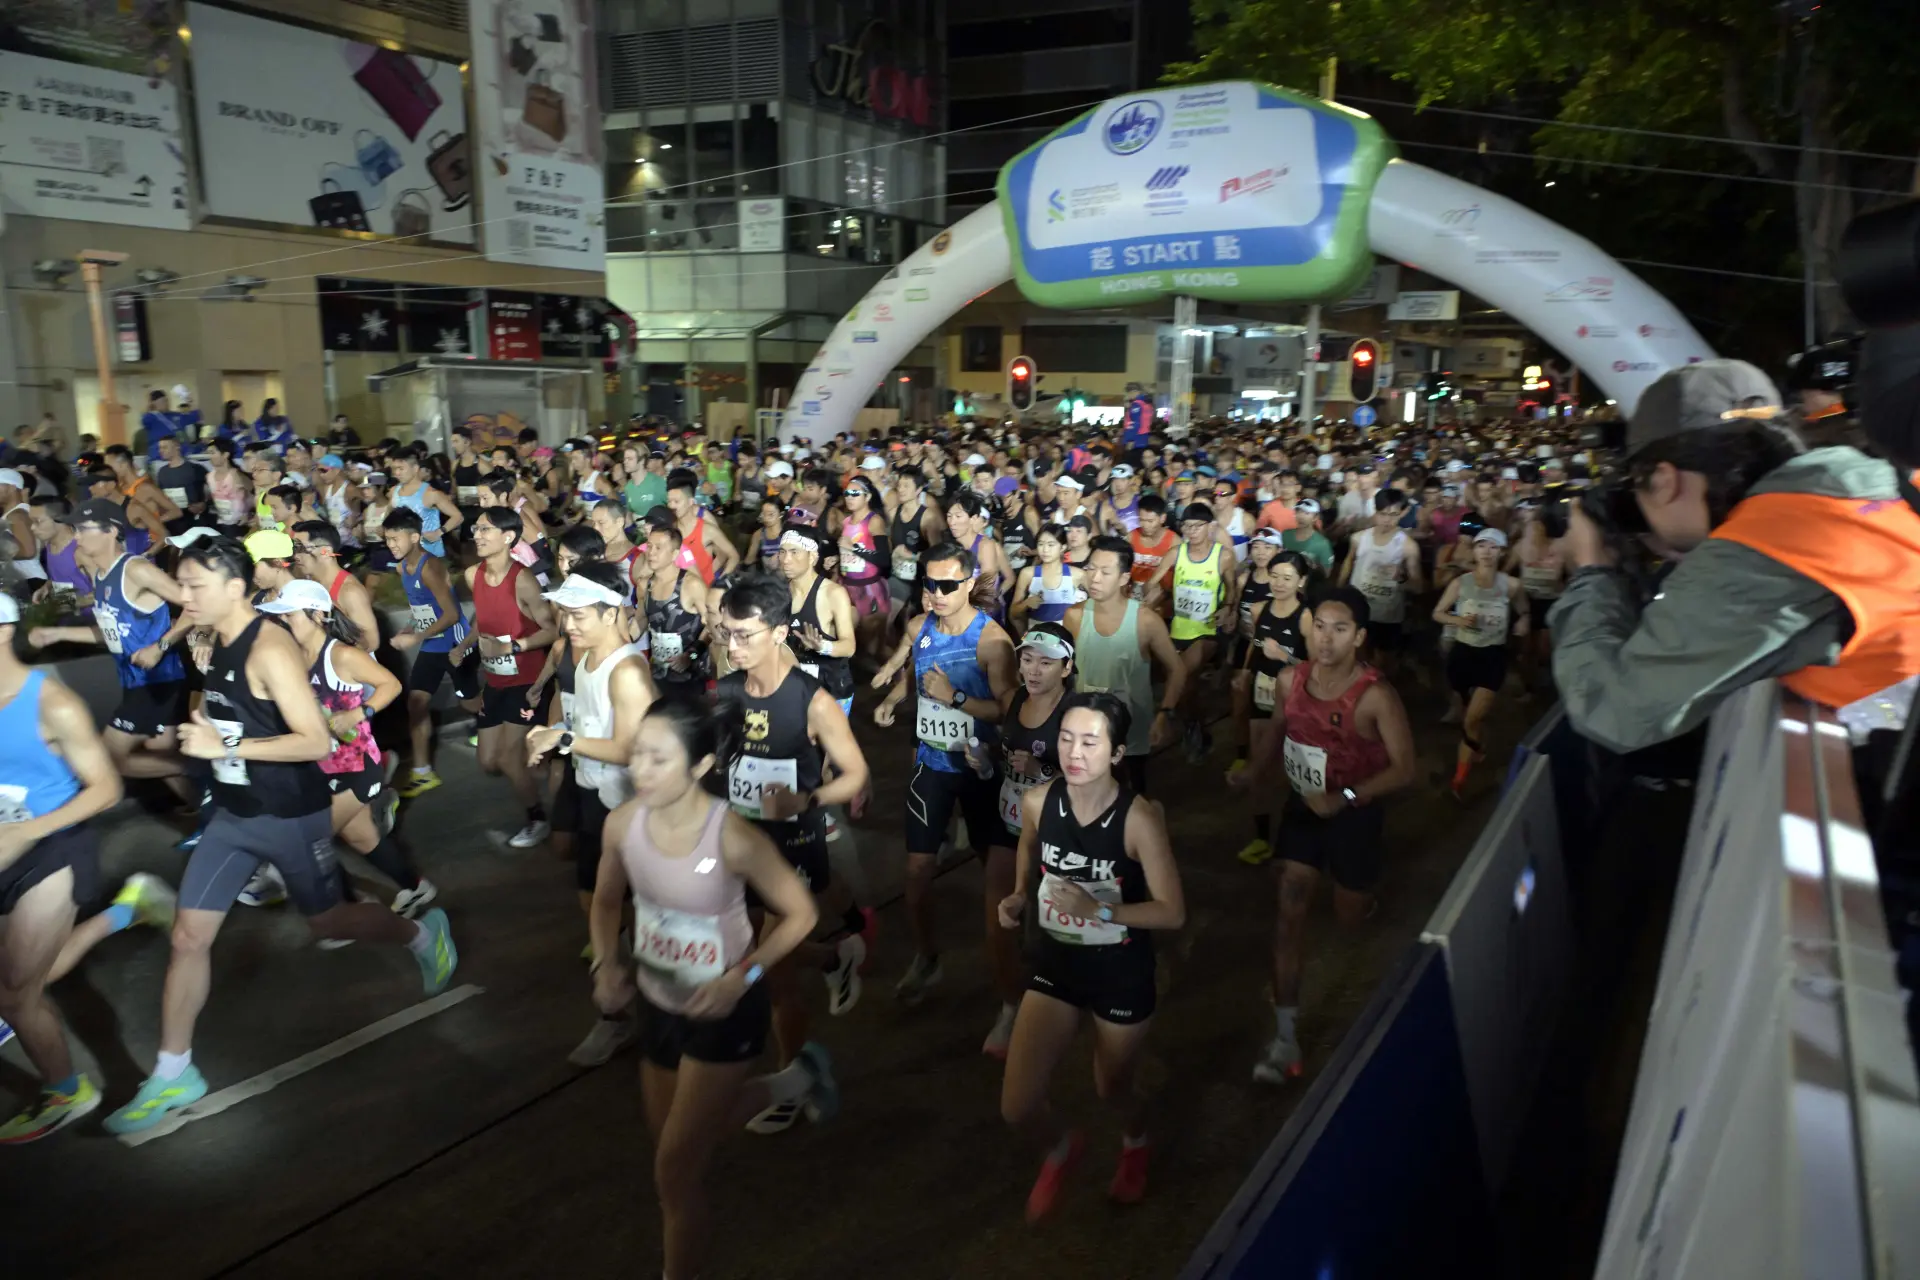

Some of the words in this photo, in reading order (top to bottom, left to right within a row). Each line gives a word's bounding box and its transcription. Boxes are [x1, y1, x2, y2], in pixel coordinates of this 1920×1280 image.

[218, 101, 297, 127] BRAND
[301, 117, 343, 136] OFF
[1123, 240, 1201, 265] START
[1101, 276, 1163, 294] HONG
[1172, 272, 1239, 287] KONG
[1178, 597, 1209, 613] 52127
[920, 717, 969, 739] 51131
[1091, 858, 1116, 880] HK
